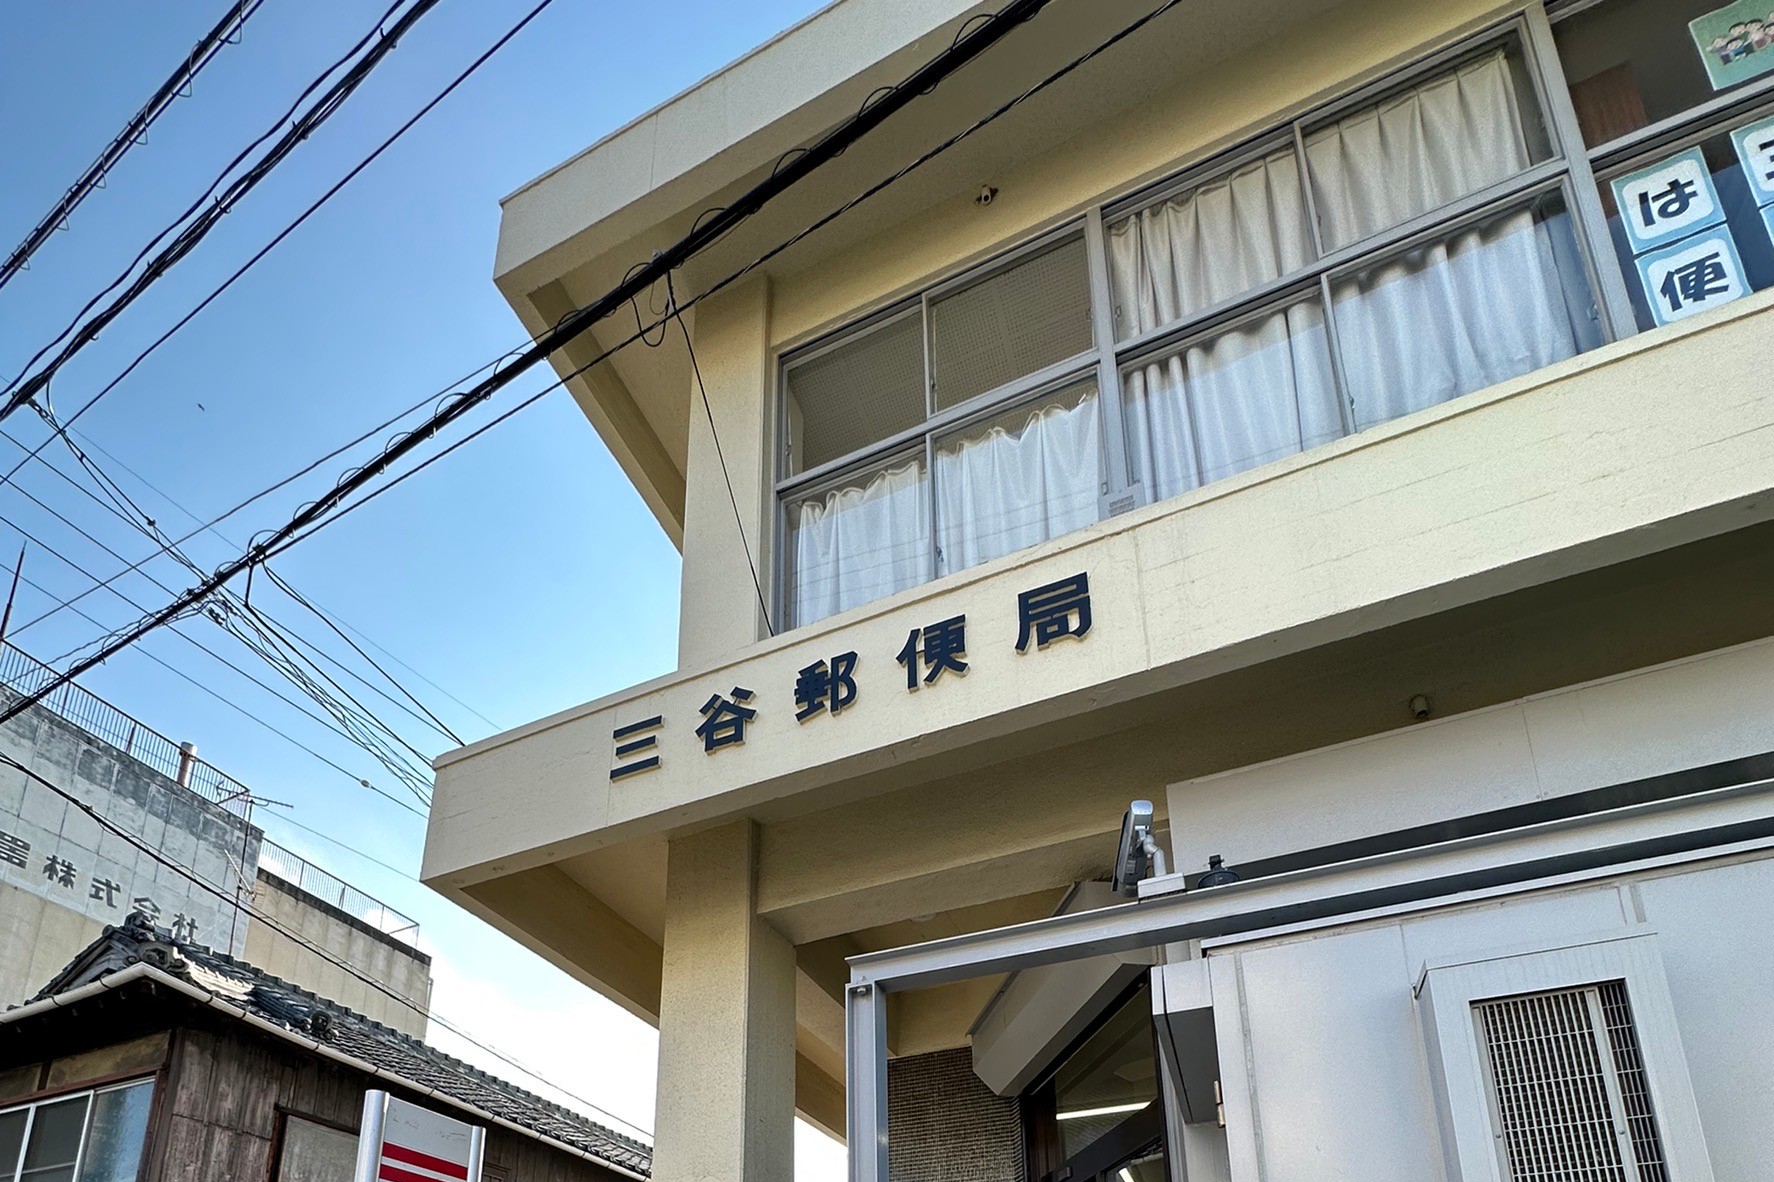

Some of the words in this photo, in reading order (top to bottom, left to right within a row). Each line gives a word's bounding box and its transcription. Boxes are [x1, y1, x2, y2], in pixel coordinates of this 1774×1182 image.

[1638, 178, 1699, 228] は
[1660, 251, 1730, 312] 便
[609, 571, 1094, 782] 三谷郵便局
